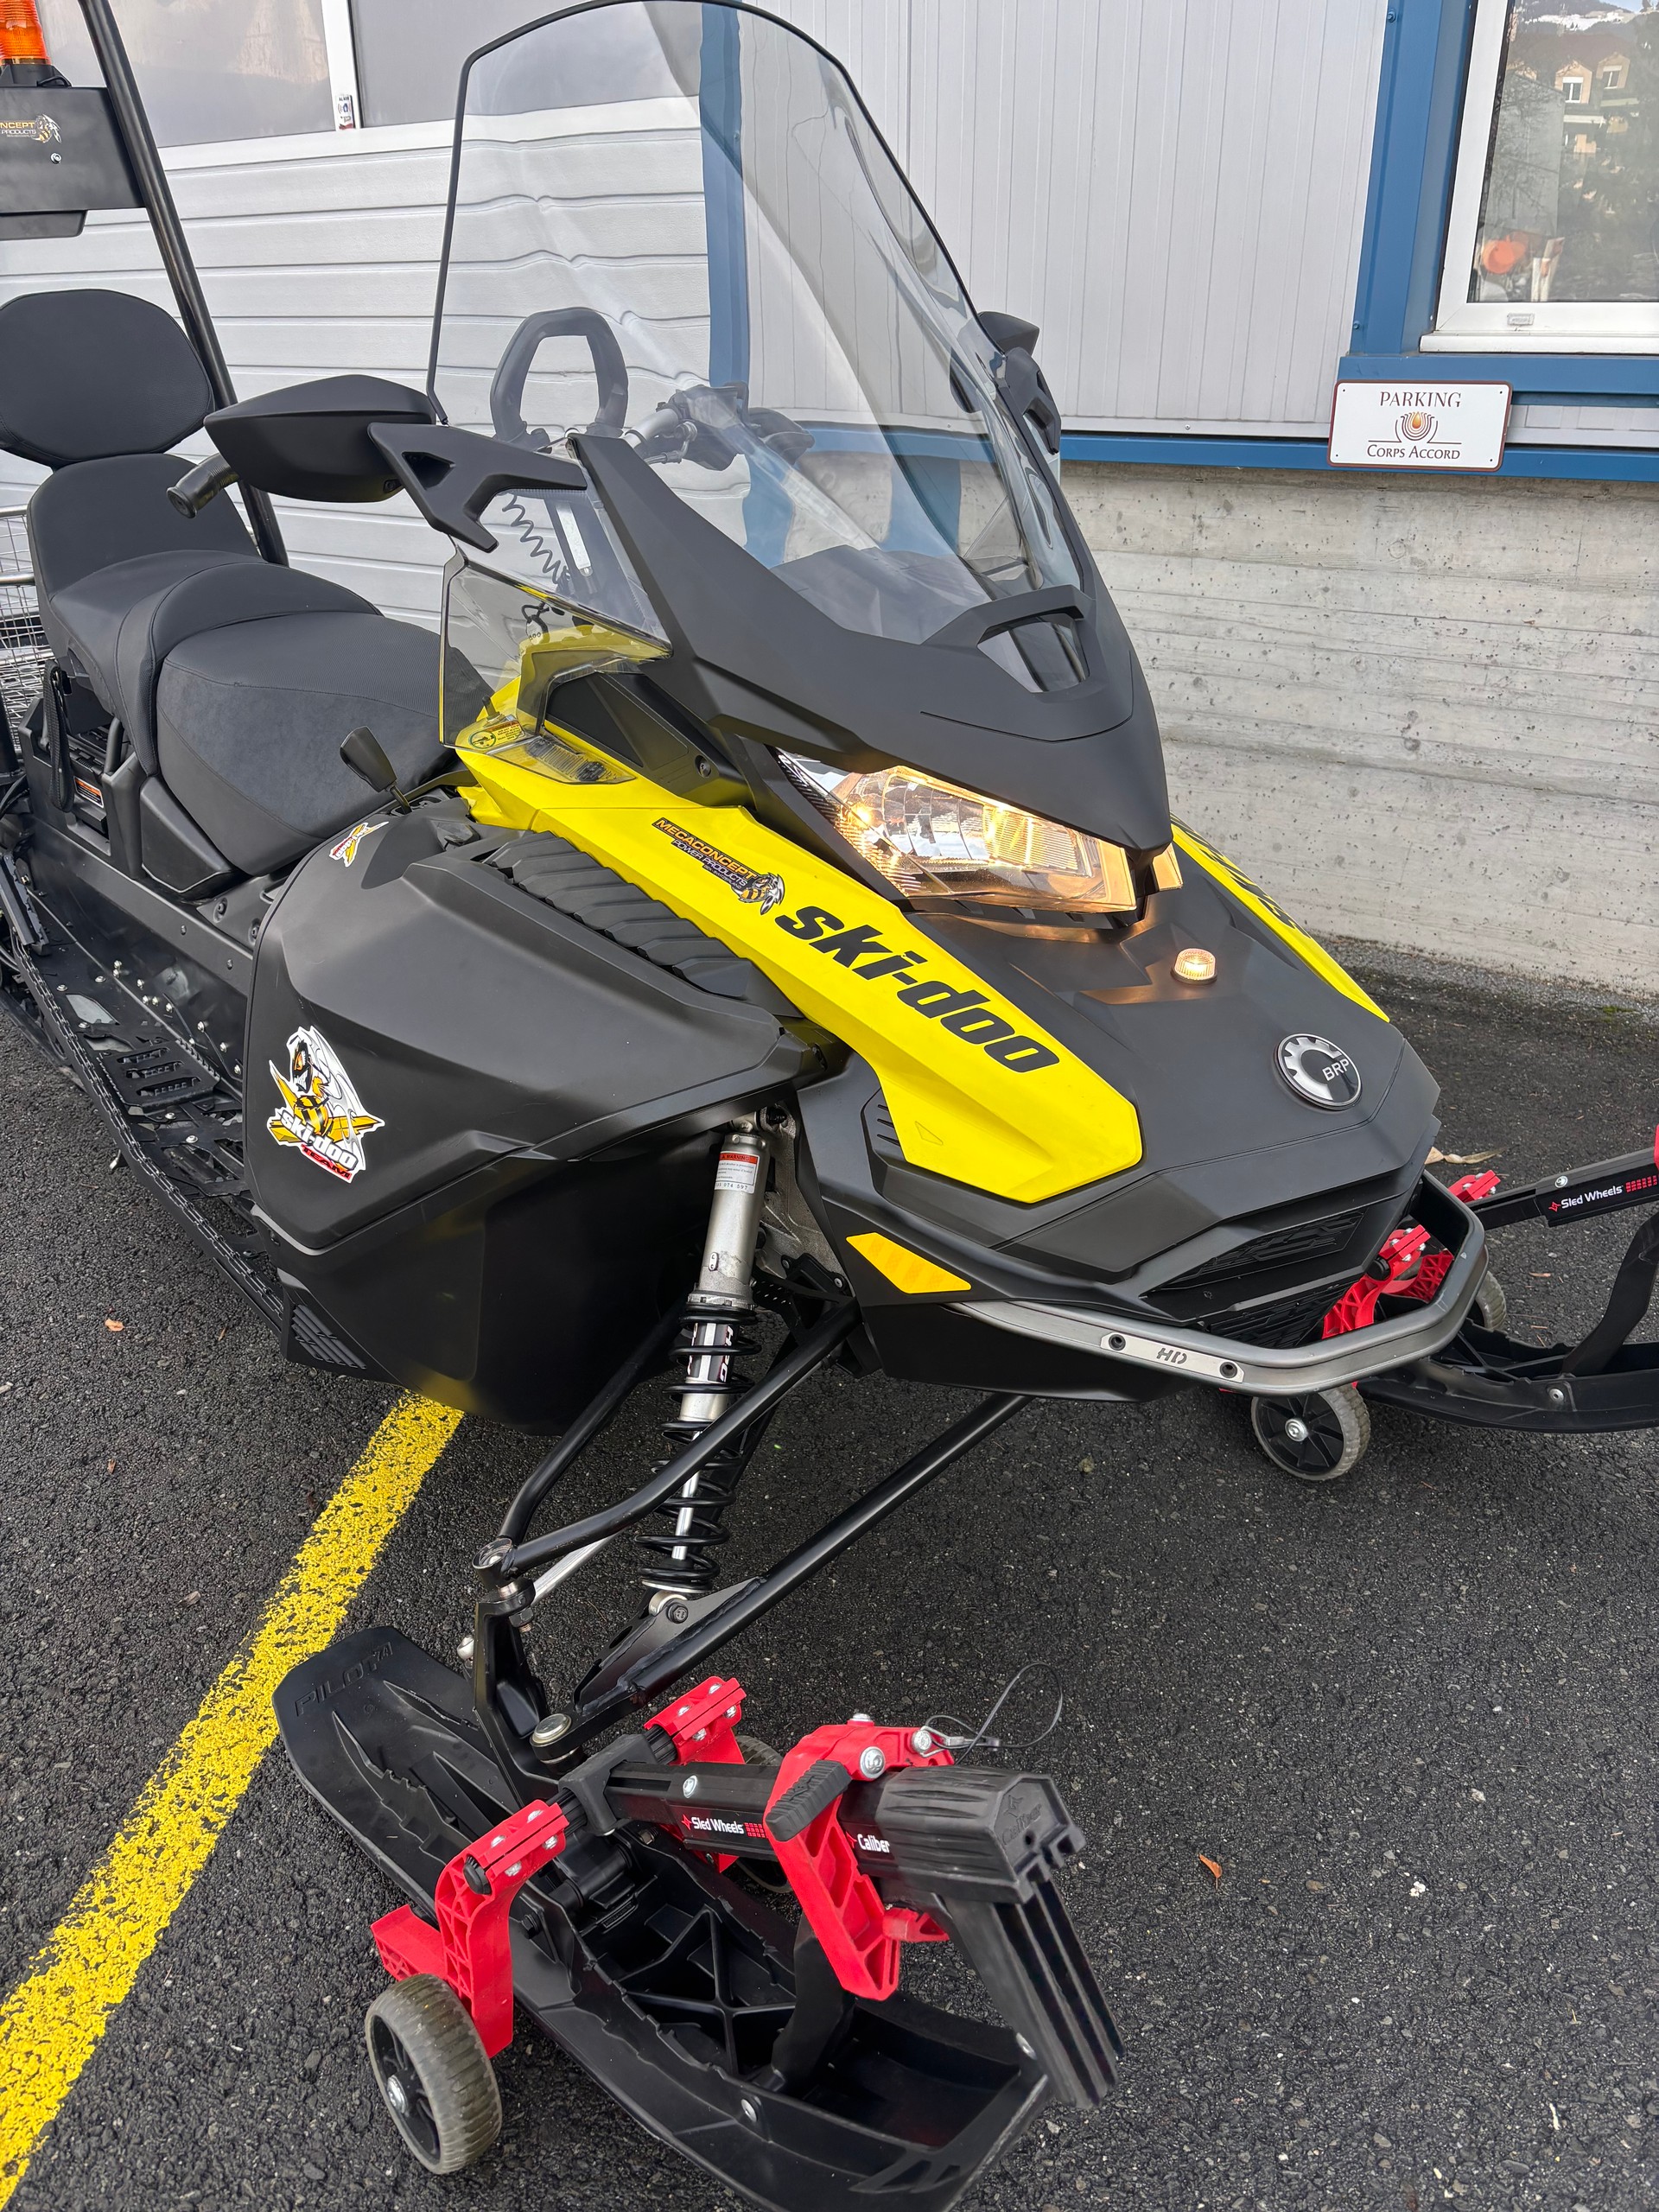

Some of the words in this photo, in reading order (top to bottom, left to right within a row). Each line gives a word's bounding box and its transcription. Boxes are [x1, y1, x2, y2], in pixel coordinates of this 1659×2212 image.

[1380, 391, 1462, 408] PARKING
[656, 819, 757, 880] MECACONCEPT
[672, 840, 702, 860] POWER
[702, 857, 748, 887] PRODUCTS
[1322, 1058, 1350, 1081] BRP
[1560, 1194, 1583, 1209] Sled
[1585, 1185, 1623, 1202] Wheels
[1156, 1347, 1188, 1364] HD
[294, 1655, 378, 1718] PILOT
[690, 1816, 712, 1830] Sled
[711, 1818, 745, 1834] Wheels
[857, 1834, 890, 1853] Caliber
